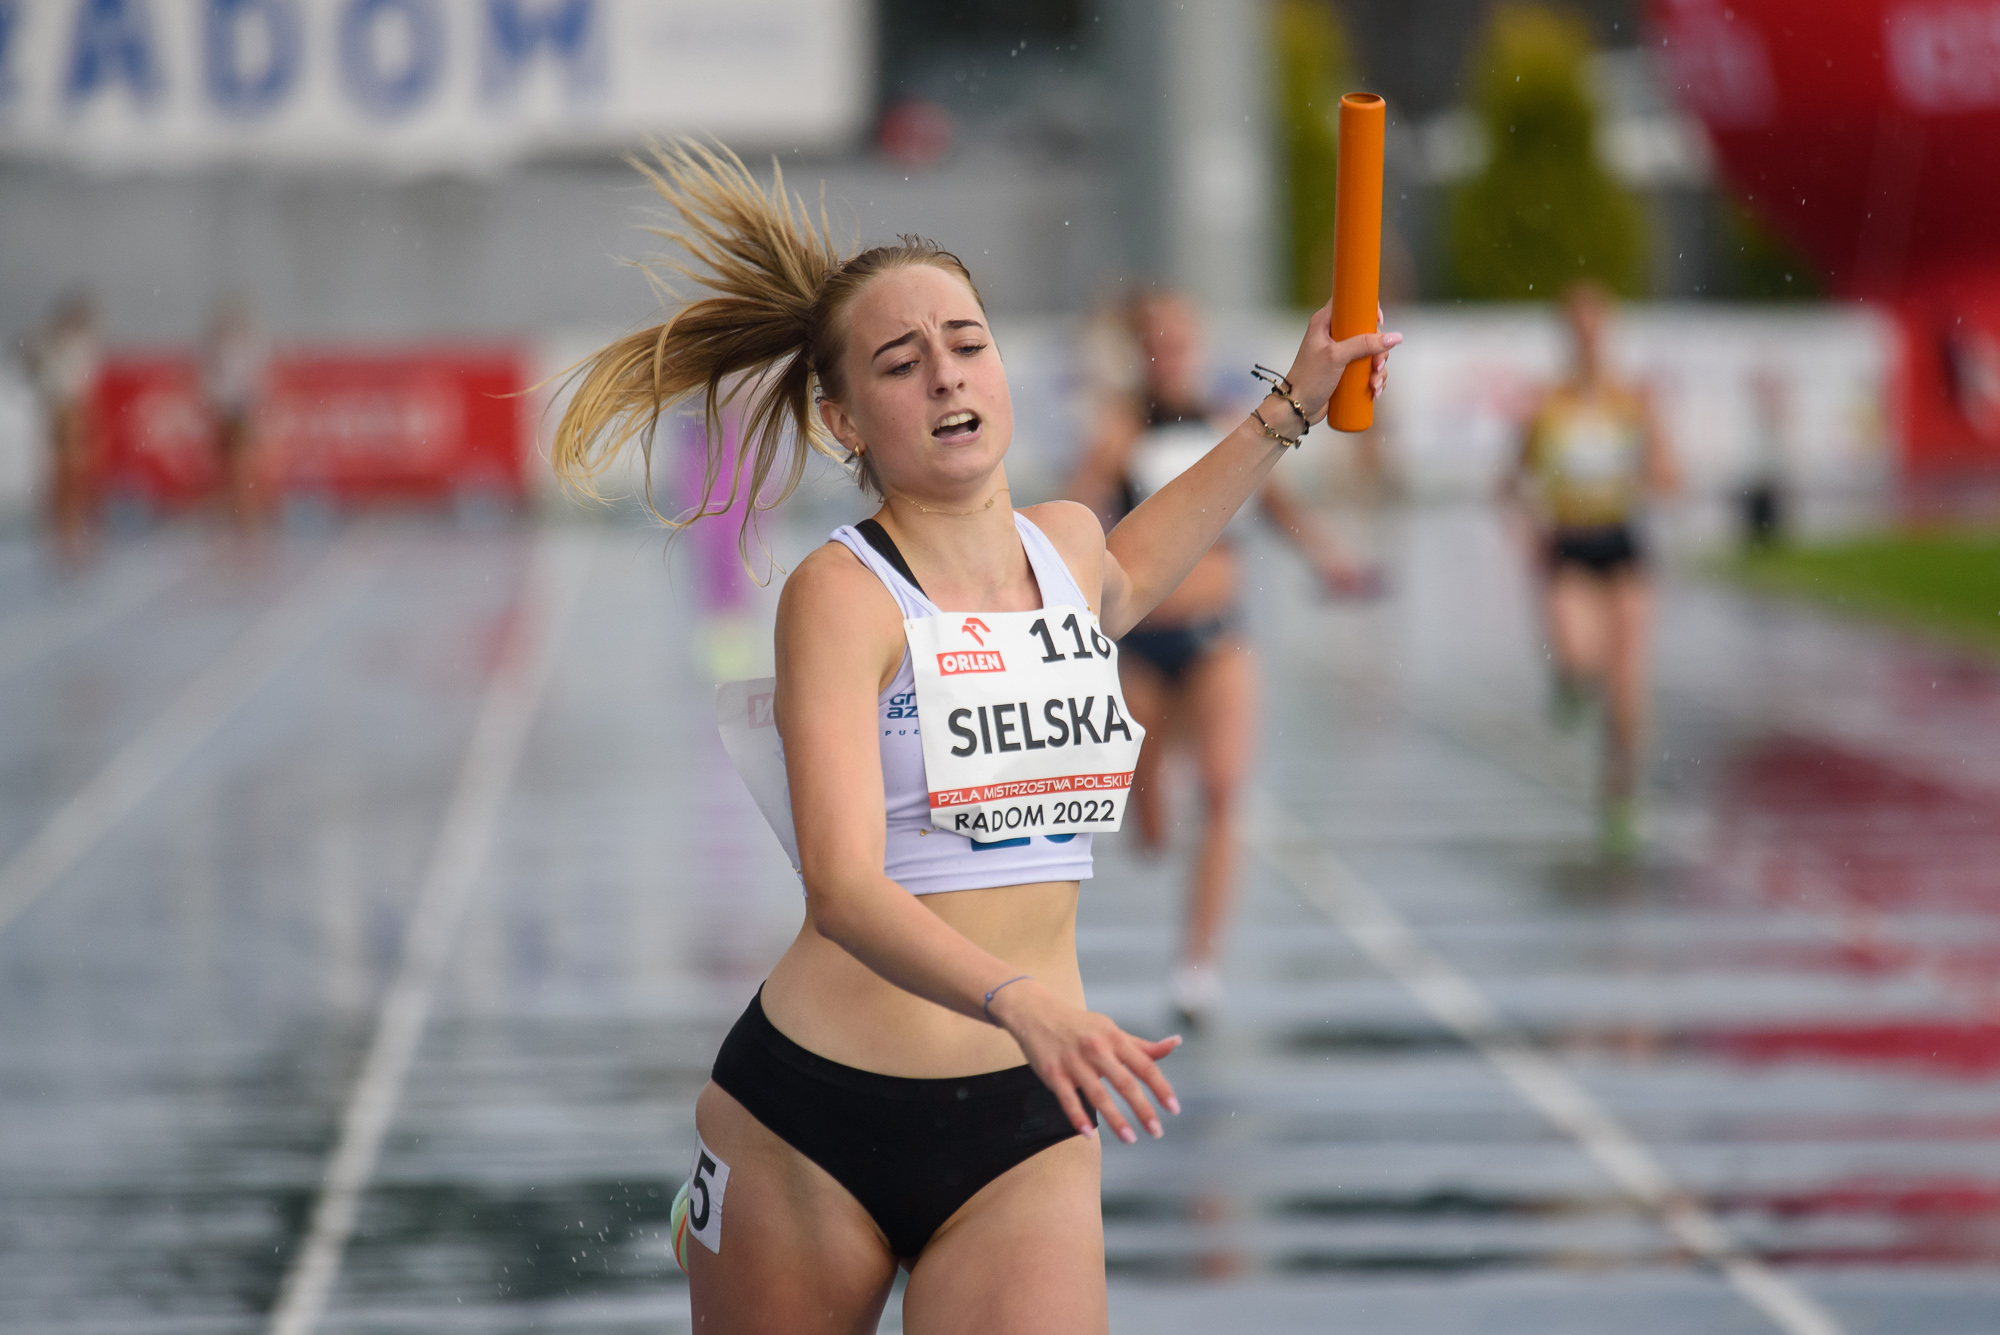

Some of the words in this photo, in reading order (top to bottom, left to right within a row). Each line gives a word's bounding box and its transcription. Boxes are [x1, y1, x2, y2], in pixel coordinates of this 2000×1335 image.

[0, 0, 605, 118] ADOM
[942, 653, 1001, 673] ORLEN
[1028, 613, 1111, 664] 116
[947, 695, 1132, 757] SIELSKA
[937, 789, 981, 806] PZLA
[984, 779, 1071, 800] MISTRZOSTWA
[1074, 775, 1122, 789] POLSKI
[954, 804, 1045, 833] RADOM
[1052, 800, 1115, 824] 2022
[690, 1149, 716, 1231] 5
